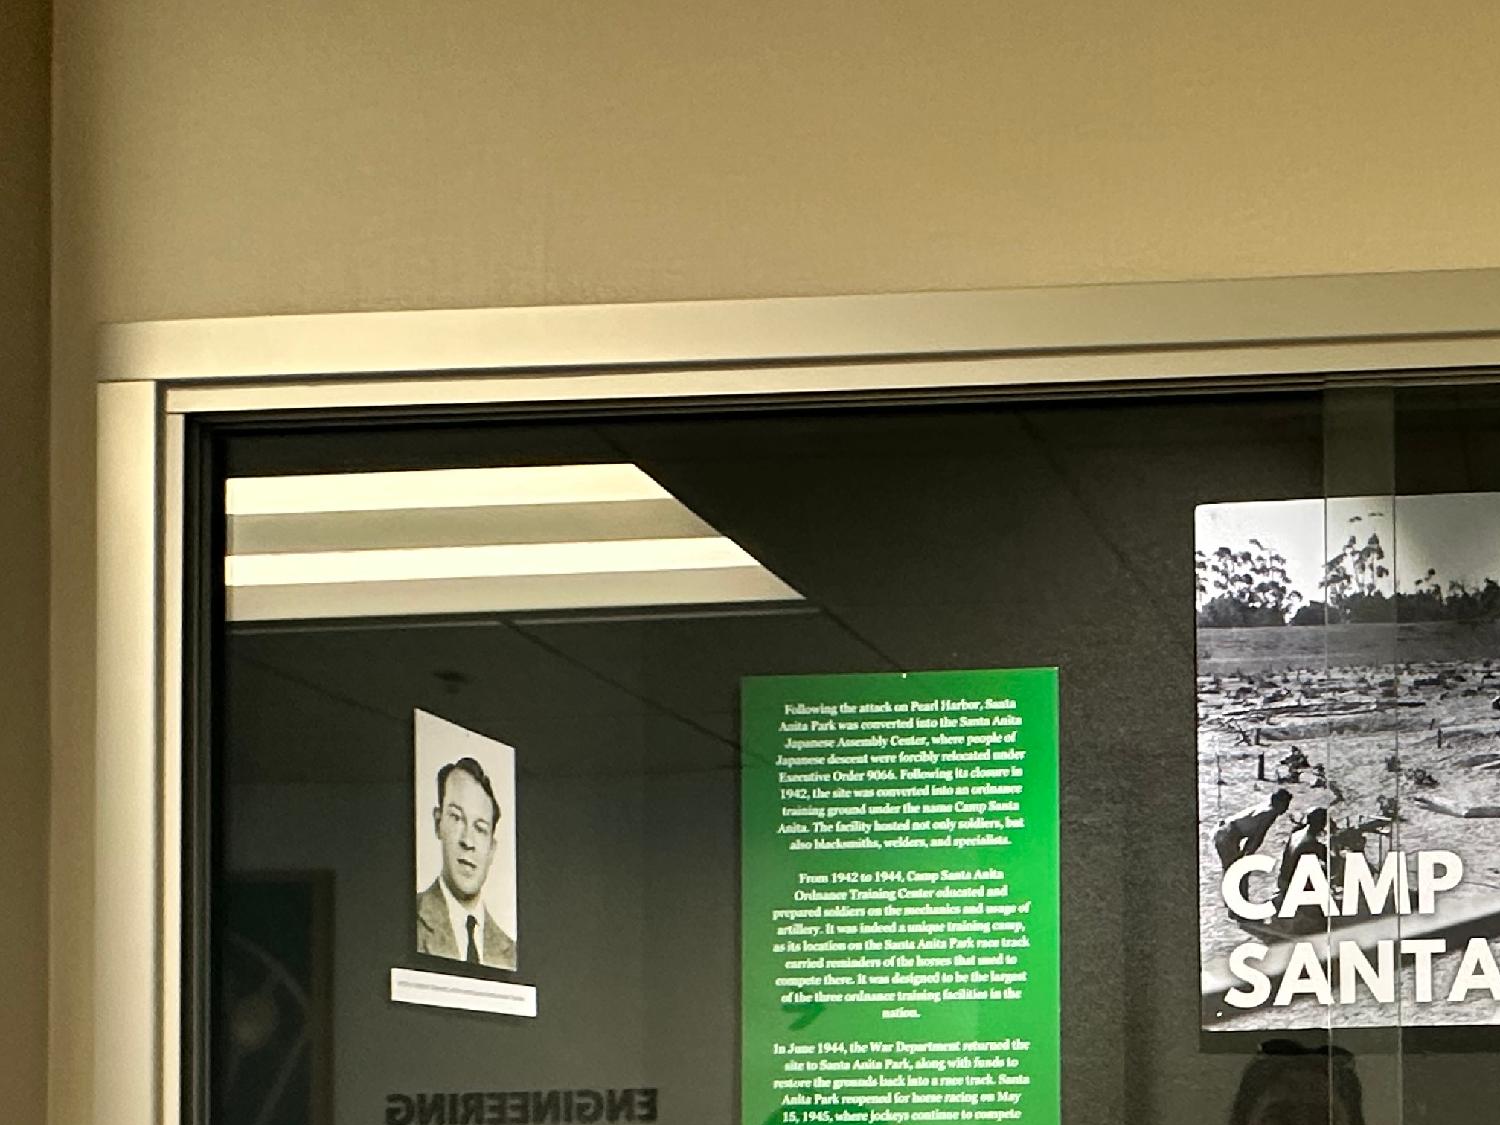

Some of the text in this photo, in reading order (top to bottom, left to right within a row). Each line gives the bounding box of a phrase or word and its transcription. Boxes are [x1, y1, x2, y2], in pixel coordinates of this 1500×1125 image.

[785, 703, 837, 717] Following
[839, 702, 857, 713] the
[859, 701, 892, 713] attack
[893, 702, 908, 712] on
[910, 700, 938, 711] Pearl
[983, 697, 1016, 709] Santa
[779, 714, 1022, 732] Anita Park was converted into the Santa Anita
[784, 737, 835, 751] Japanese
[836, 735, 888, 750] Assembly
[931, 733, 964, 745] where
[966, 732, 1003, 746] people
[1003, 731, 1016, 743] of
[779, 770, 830, 782] Executive
[832, 769, 865, 781] Order
[900, 767, 953, 781] Following
[954, 766, 969, 777] its
[969, 765, 1010, 777] closure
[1010, 765, 1022, 776] in
[799, 872, 828, 883] From
[831, 871, 858, 882] 1942
[859, 871, 873, 882] to
[906, 869, 939, 883] Camp
[940, 868, 972, 880] Santa
[972, 868, 1004, 879] Anita
[1221, 849, 1464, 922] CAMP
[773, 1042, 785, 1053] In
[787, 1042, 815, 1053] June
[849, 1041, 868, 1052] the
[869, 1041, 894, 1052] War
[895, 1040, 960, 1054] Department
[962, 1039, 1010, 1051] returned
[1010, 1039, 1030, 1050] the
[781, 1091, 1021, 1106] Anita Park reopened for horse racing on May
